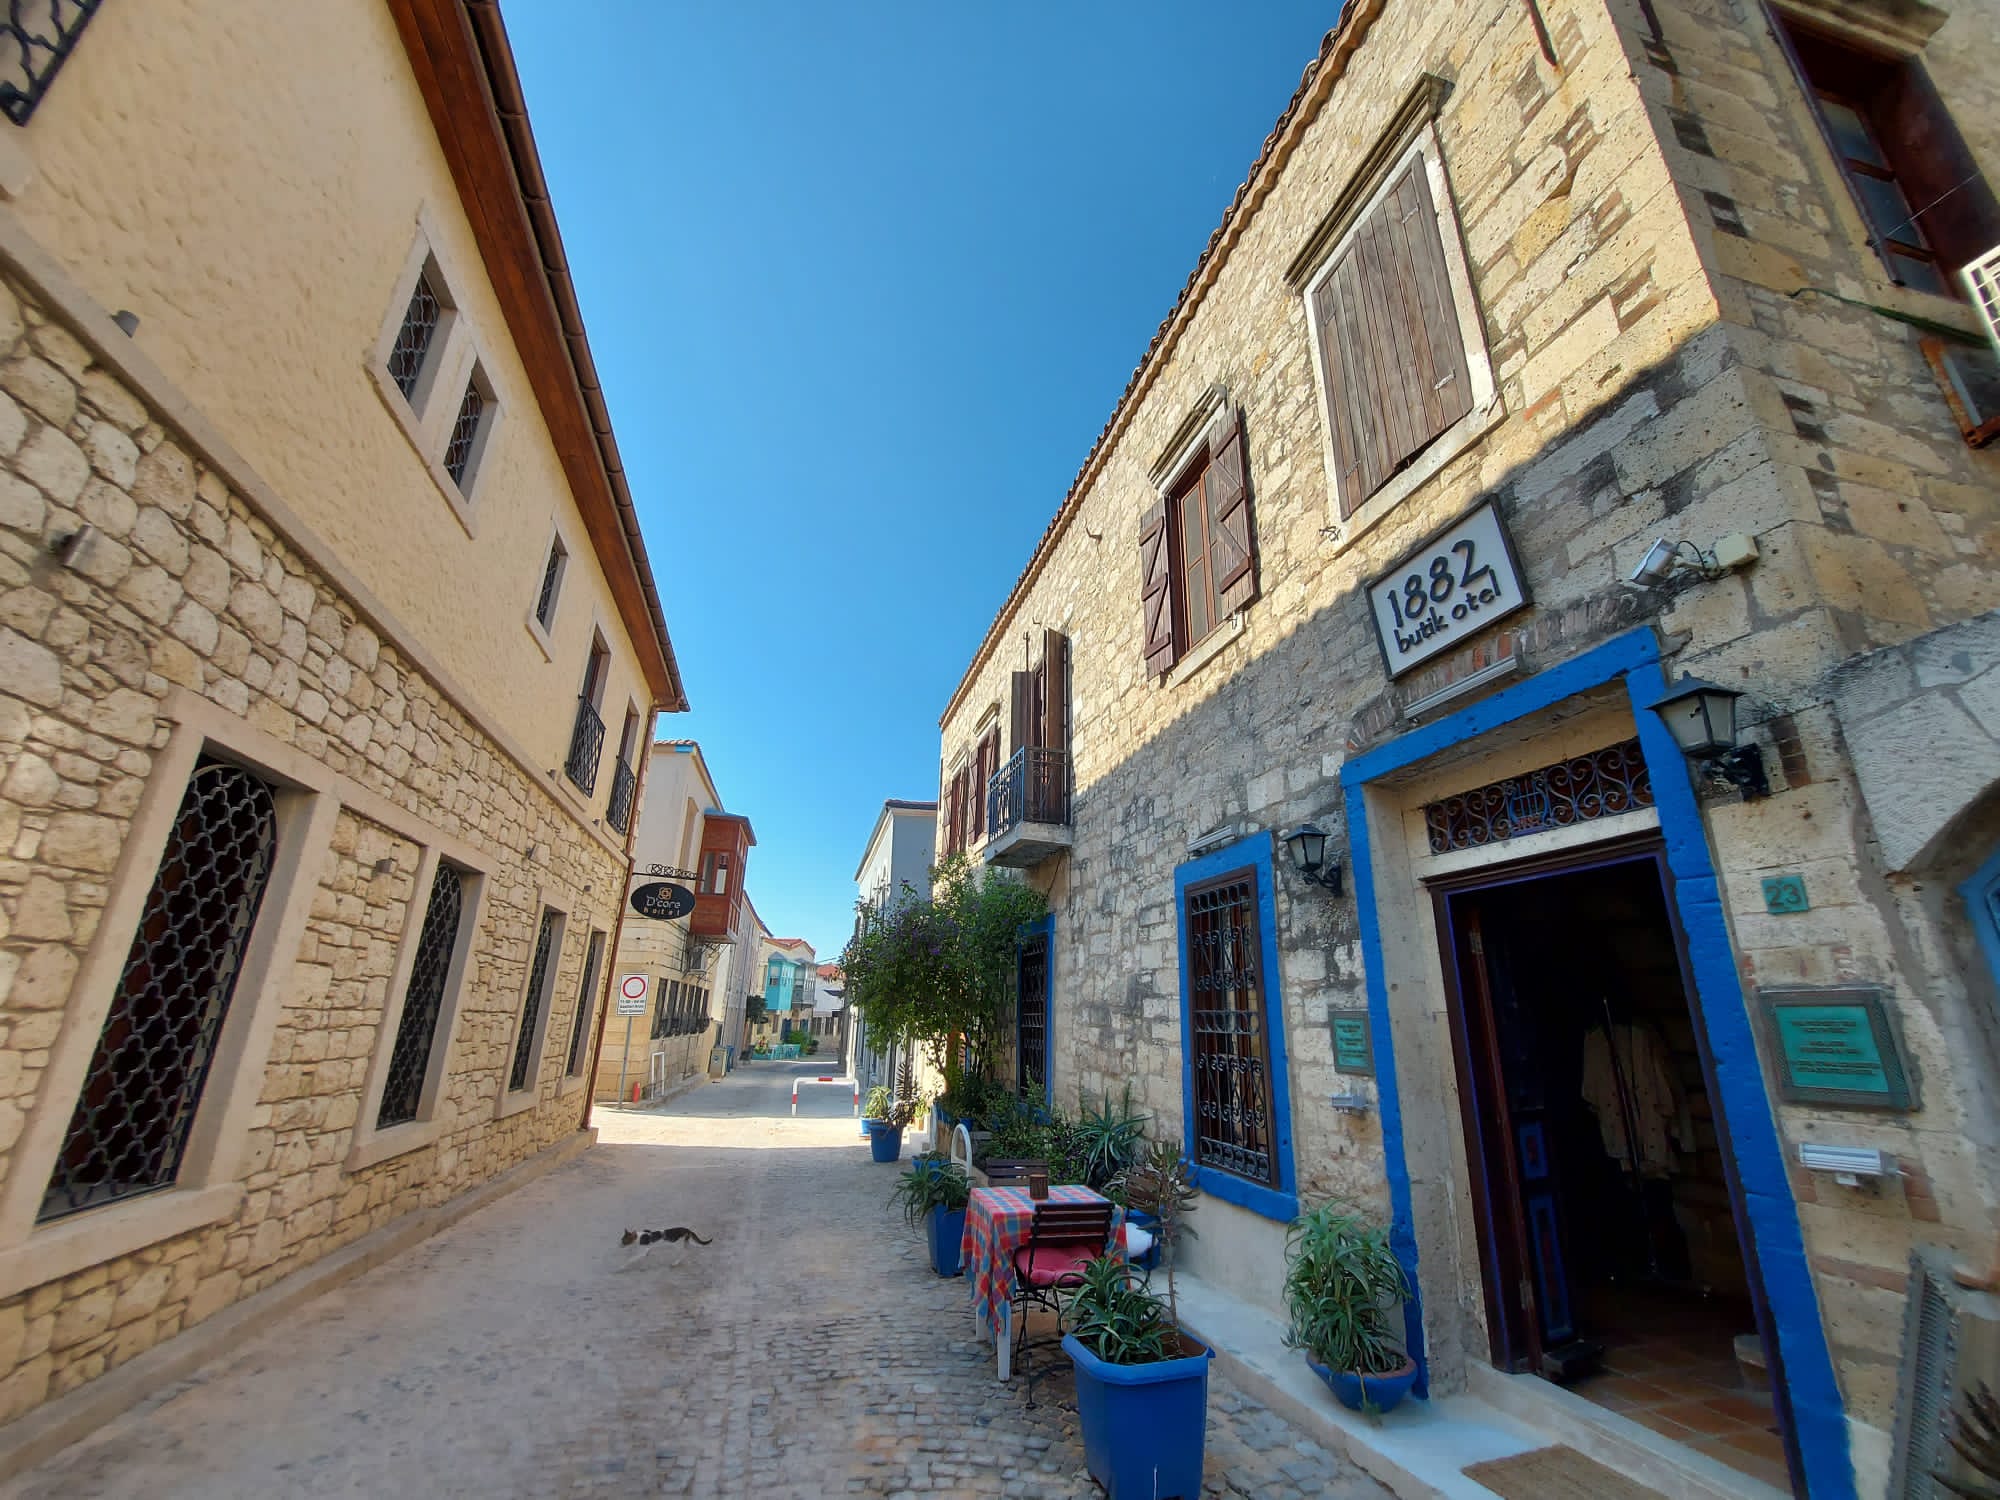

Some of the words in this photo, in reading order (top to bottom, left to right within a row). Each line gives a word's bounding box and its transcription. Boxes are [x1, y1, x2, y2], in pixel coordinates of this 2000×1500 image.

[1387, 539, 1490, 628] 1882
[1394, 606, 1449, 653] butik
[1451, 569, 1502, 620] otel
[1765, 883, 1802, 906] 23
